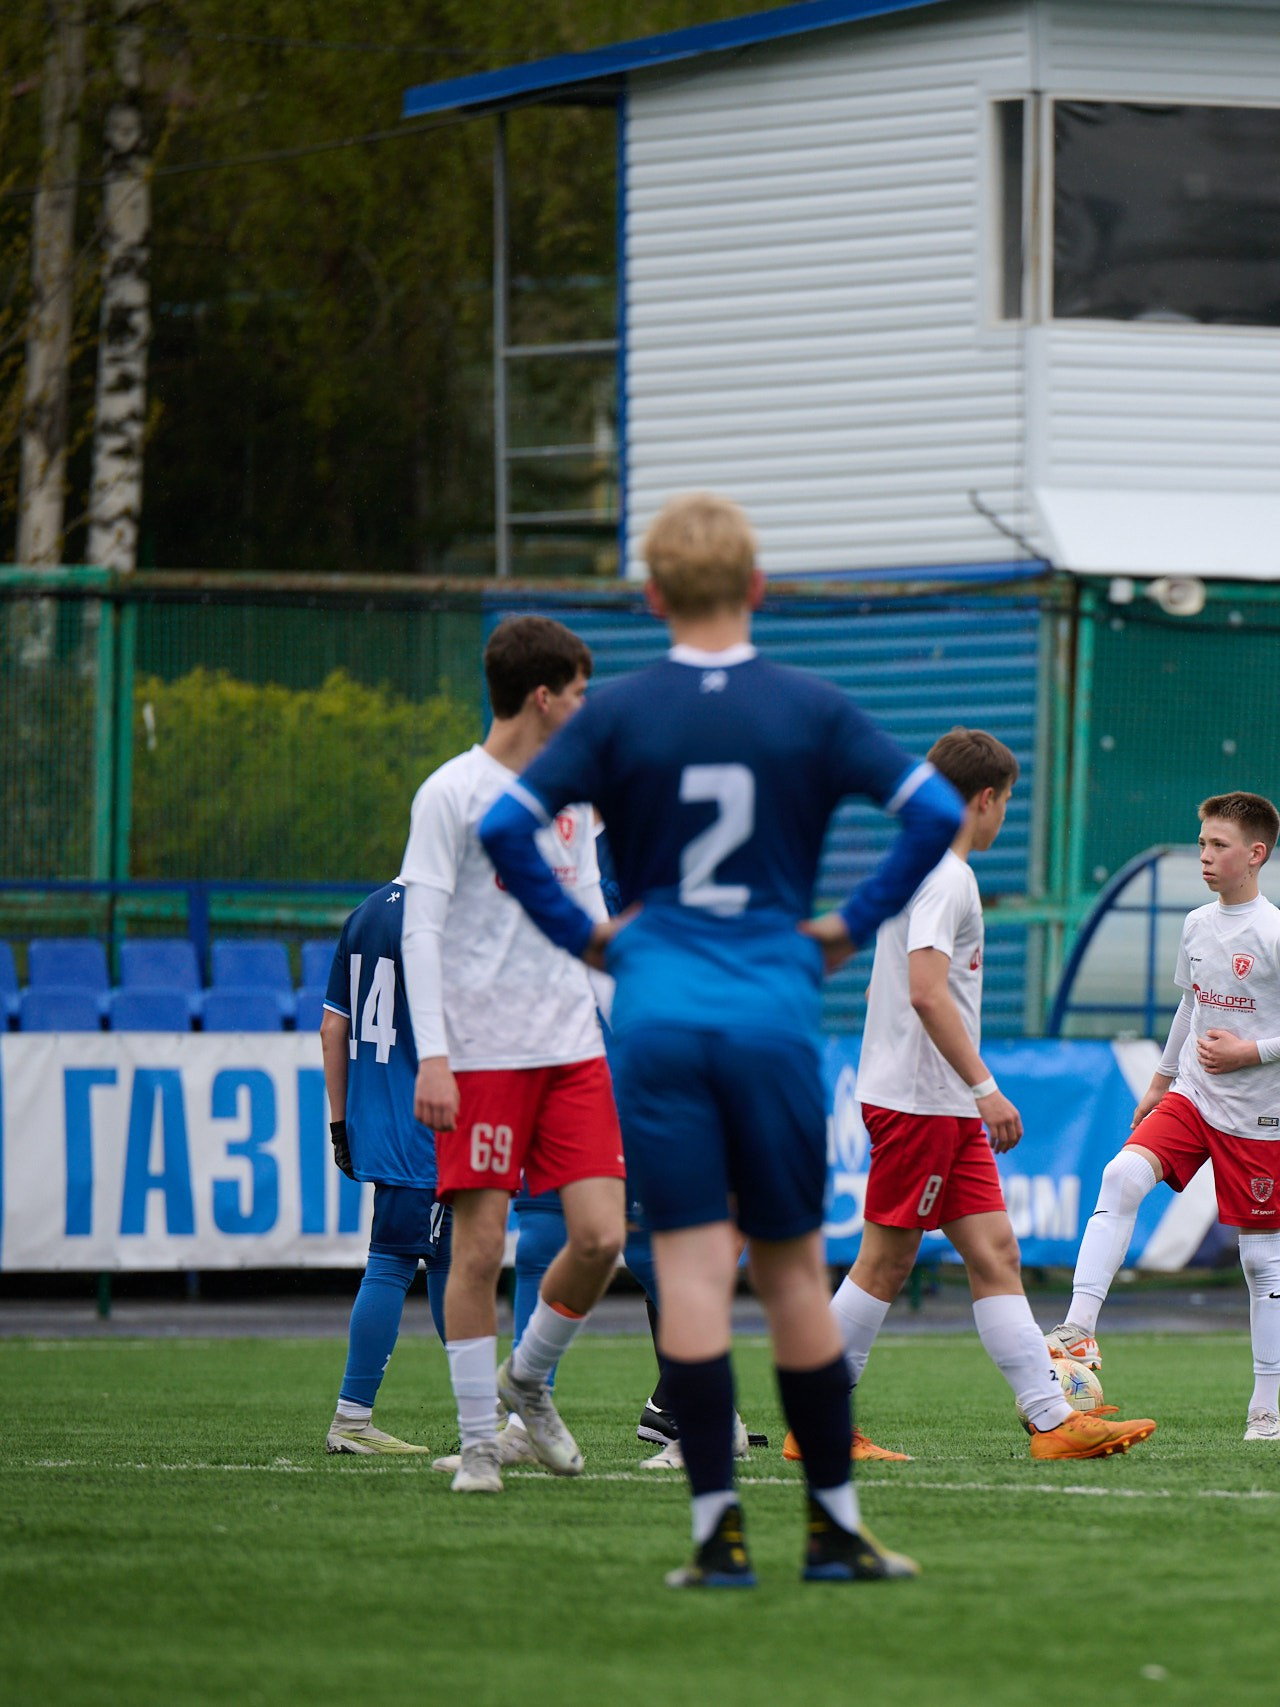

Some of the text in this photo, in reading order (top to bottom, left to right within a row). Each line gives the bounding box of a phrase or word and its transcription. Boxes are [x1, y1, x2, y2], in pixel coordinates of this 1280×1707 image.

[679, 763, 754, 917] 2
[349, 953, 397, 1065] 14
[63, 1067, 362, 1236] ГАЗП
[470, 1122, 513, 1175] 69
[917, 1174, 943, 1217] 8
